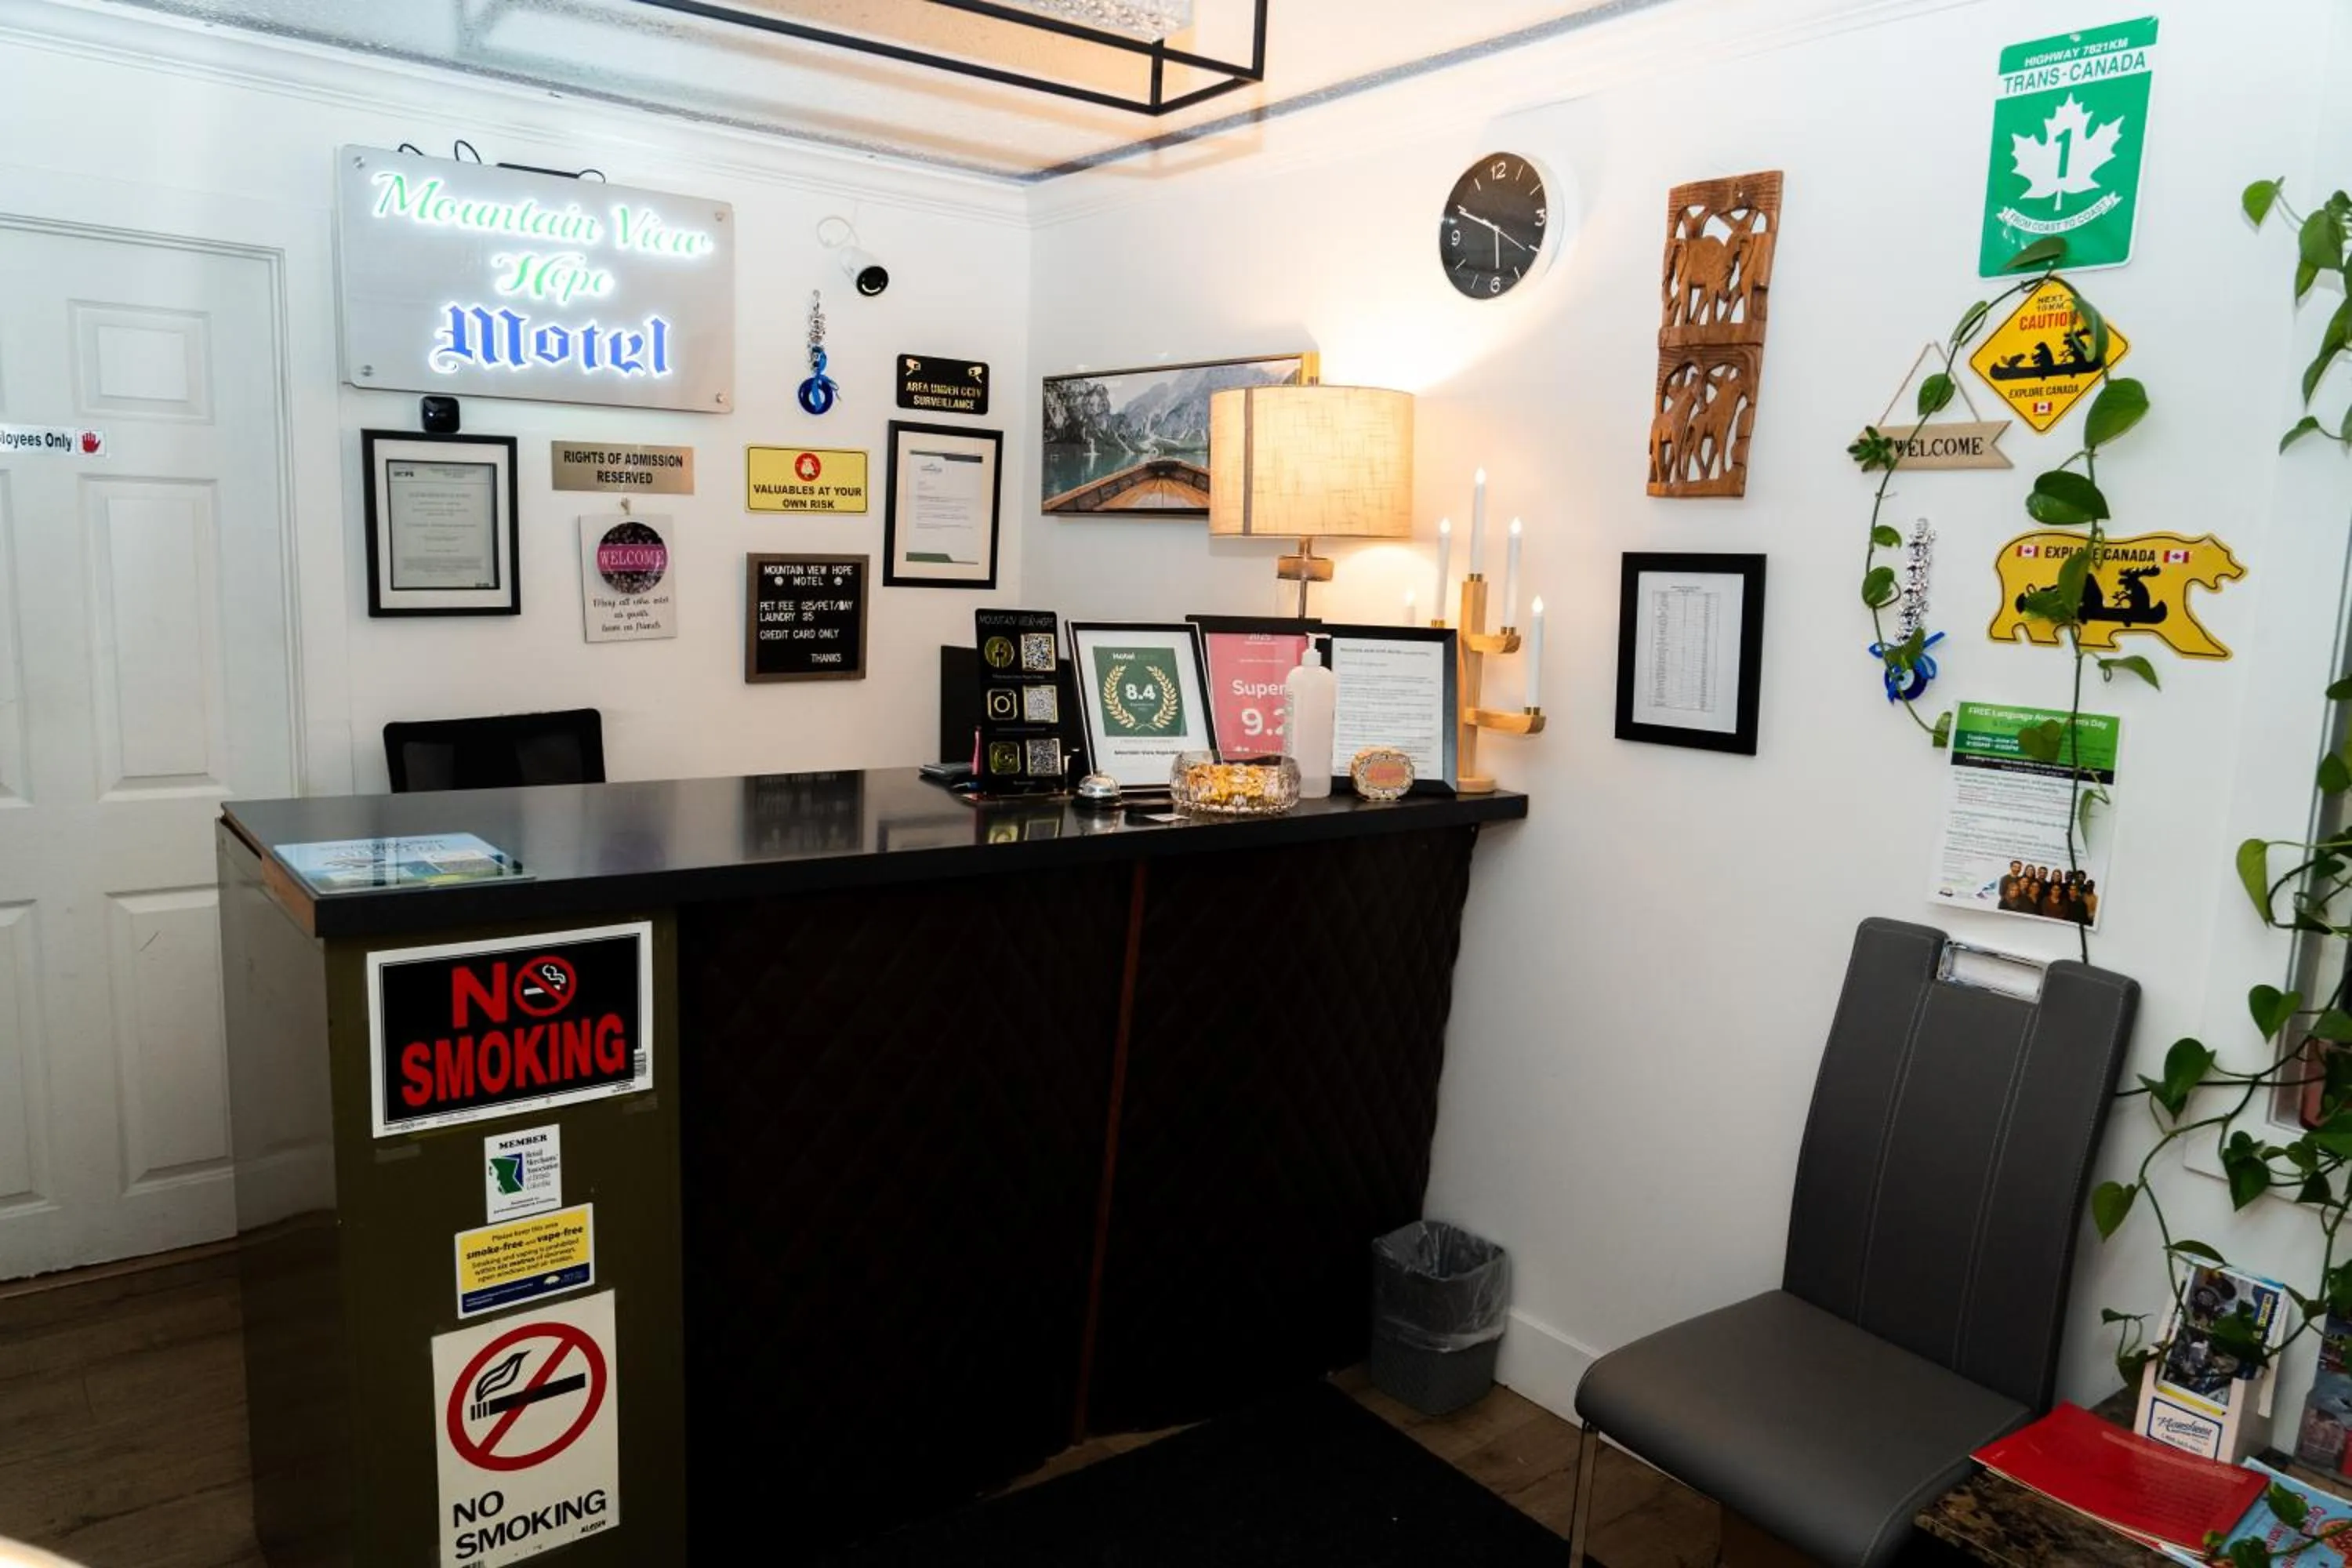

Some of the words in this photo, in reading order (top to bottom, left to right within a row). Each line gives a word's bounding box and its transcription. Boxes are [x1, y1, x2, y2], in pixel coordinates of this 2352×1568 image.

[2024, 48, 2080, 67] HIGHWAY
[2004, 51, 2146, 94] TRANS-CANADA
[2054, 128, 2072, 179] 1
[1490, 162, 1506, 180] 12
[372, 170, 605, 246] Mountain
[610, 201, 715, 260] View
[1534, 208, 1545, 227] 3
[1451, 230, 1461, 246] 9
[491, 251, 618, 307] Hope
[1490, 276, 1501, 292] 6
[2037, 295, 2064, 303] NEXT
[429, 301, 674, 379] Motel
[906, 382, 929, 392] AREA
[2009, 387, 2044, 399] EXPLORE
[2045, 383, 2079, 396] CANADA
[913, 394, 975, 410] SURVEILLANCE
[0, 430, 42, 448] loyees
[45, 432, 72, 452] Only
[1894, 437, 1984, 457] WELCOME
[564, 451, 604, 463] RIGHTS
[608, 452, 622, 464] OF
[625, 453, 683, 467] ADMISSION
[597, 470, 653, 484] RESERVED
[753, 484, 815, 495] VALUABLES
[818, 487, 831, 495] AT
[833, 487, 862, 496] YOUR
[782, 499, 807, 509] OWN
[810, 499, 834, 509] RISK
[600, 550, 664, 566] WELCOME
[2045, 545, 2100, 561] EXPLE
[2103, 549, 2156, 563] CANADA
[764, 565, 804, 575] MOUNTAIN
[807, 565, 827, 575] VIEW
[832, 565, 854, 575] HOPE
[793, 576, 824, 586] MOTEL
[760, 601, 775, 611] PET
[779, 601, 795, 611] FEE
[760, 612, 795, 622] LAUNDRY
[760, 630, 789, 640] CREDIT
[793, 630, 815, 639] CARD
[818, 629, 840, 638] ONLY
[811, 653, 841, 662] THANKS
[1125, 683, 1156, 700] 8.4
[1232, 680, 1287, 699] Super
[401, 1013, 626, 1107] SMOKING
[499, 1134, 548, 1149] MEMBER
[466, 1240, 524, 1260] smoke-free
[537, 1226, 583, 1243] vape-free
[453, 1490, 503, 1528] NO
[456, 1489, 608, 1559] SMOKING
